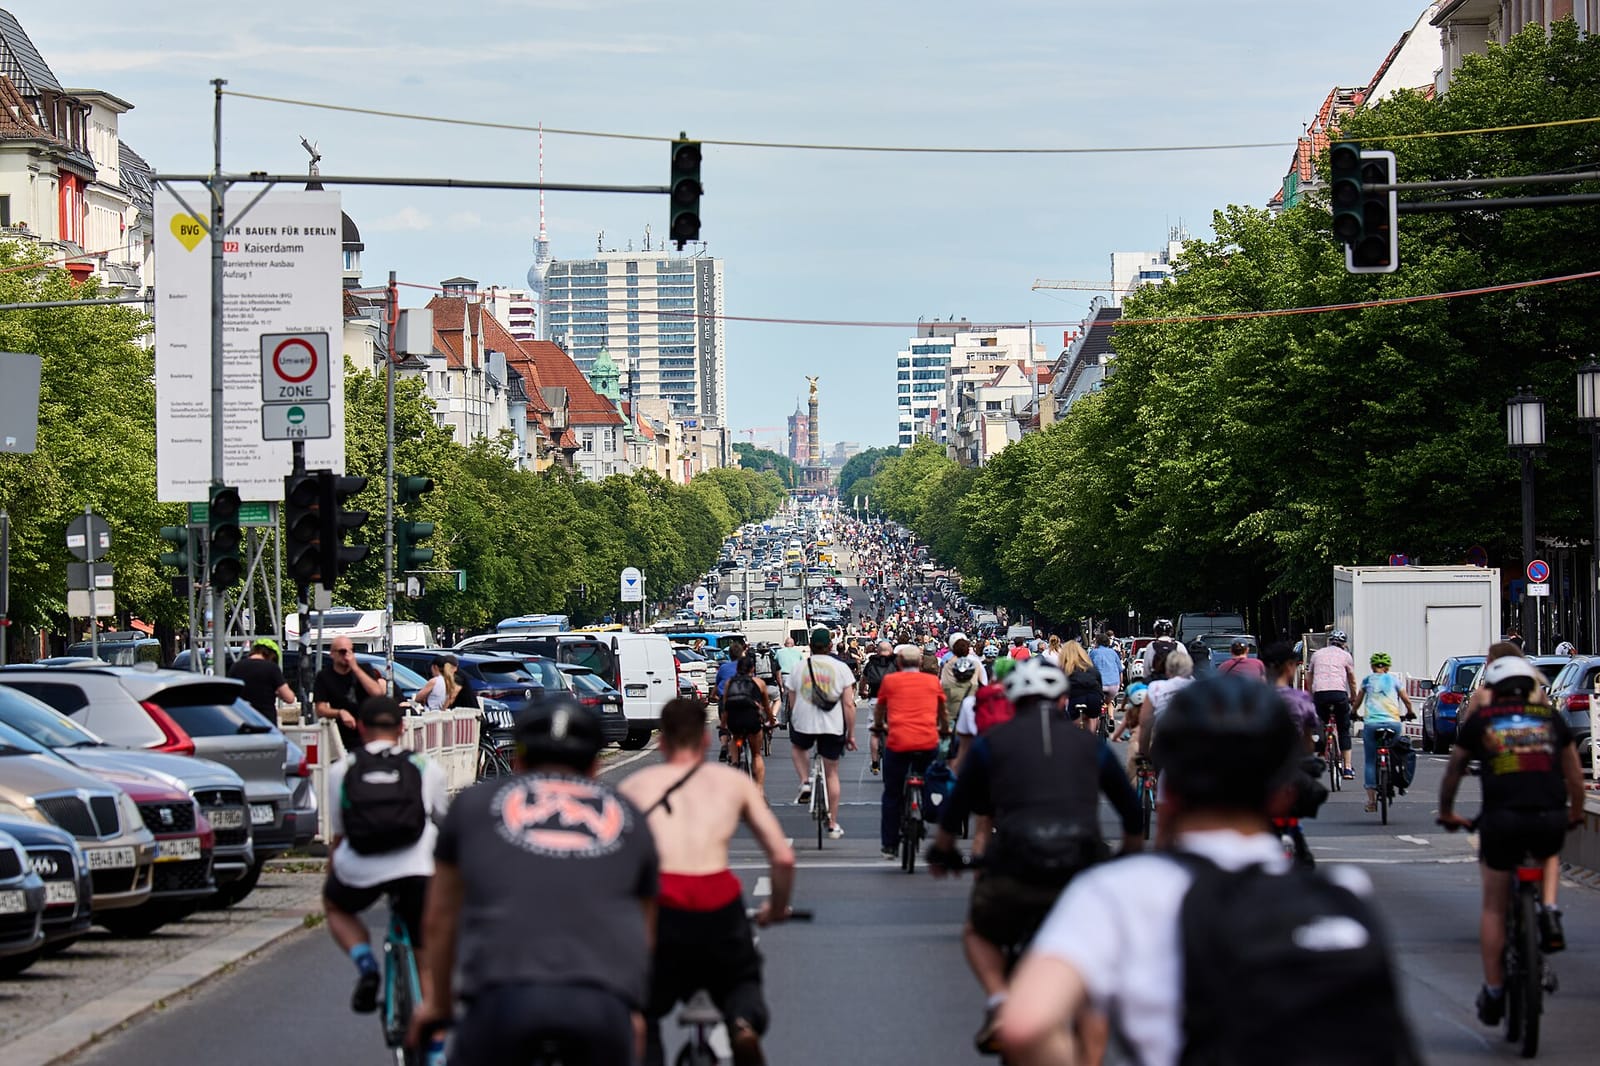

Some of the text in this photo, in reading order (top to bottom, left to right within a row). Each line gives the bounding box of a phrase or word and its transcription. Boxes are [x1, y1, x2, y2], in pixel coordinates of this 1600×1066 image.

[180, 225, 200, 235] BVG
[245, 227, 277, 235] BAUEN
[281, 226, 299, 235] FÜR
[304, 227, 337, 236] BERLIN
[224, 242, 304, 253] U2 Kaiserdamm
[269, 260, 294, 268] Ausbau
[223, 271, 247, 280] Aufzug
[703, 266, 711, 339] TECHNISCHE
[279, 356, 310, 365] Umwelt
[279, 385, 313, 397] ZONE
[286, 426, 308, 437] frei
